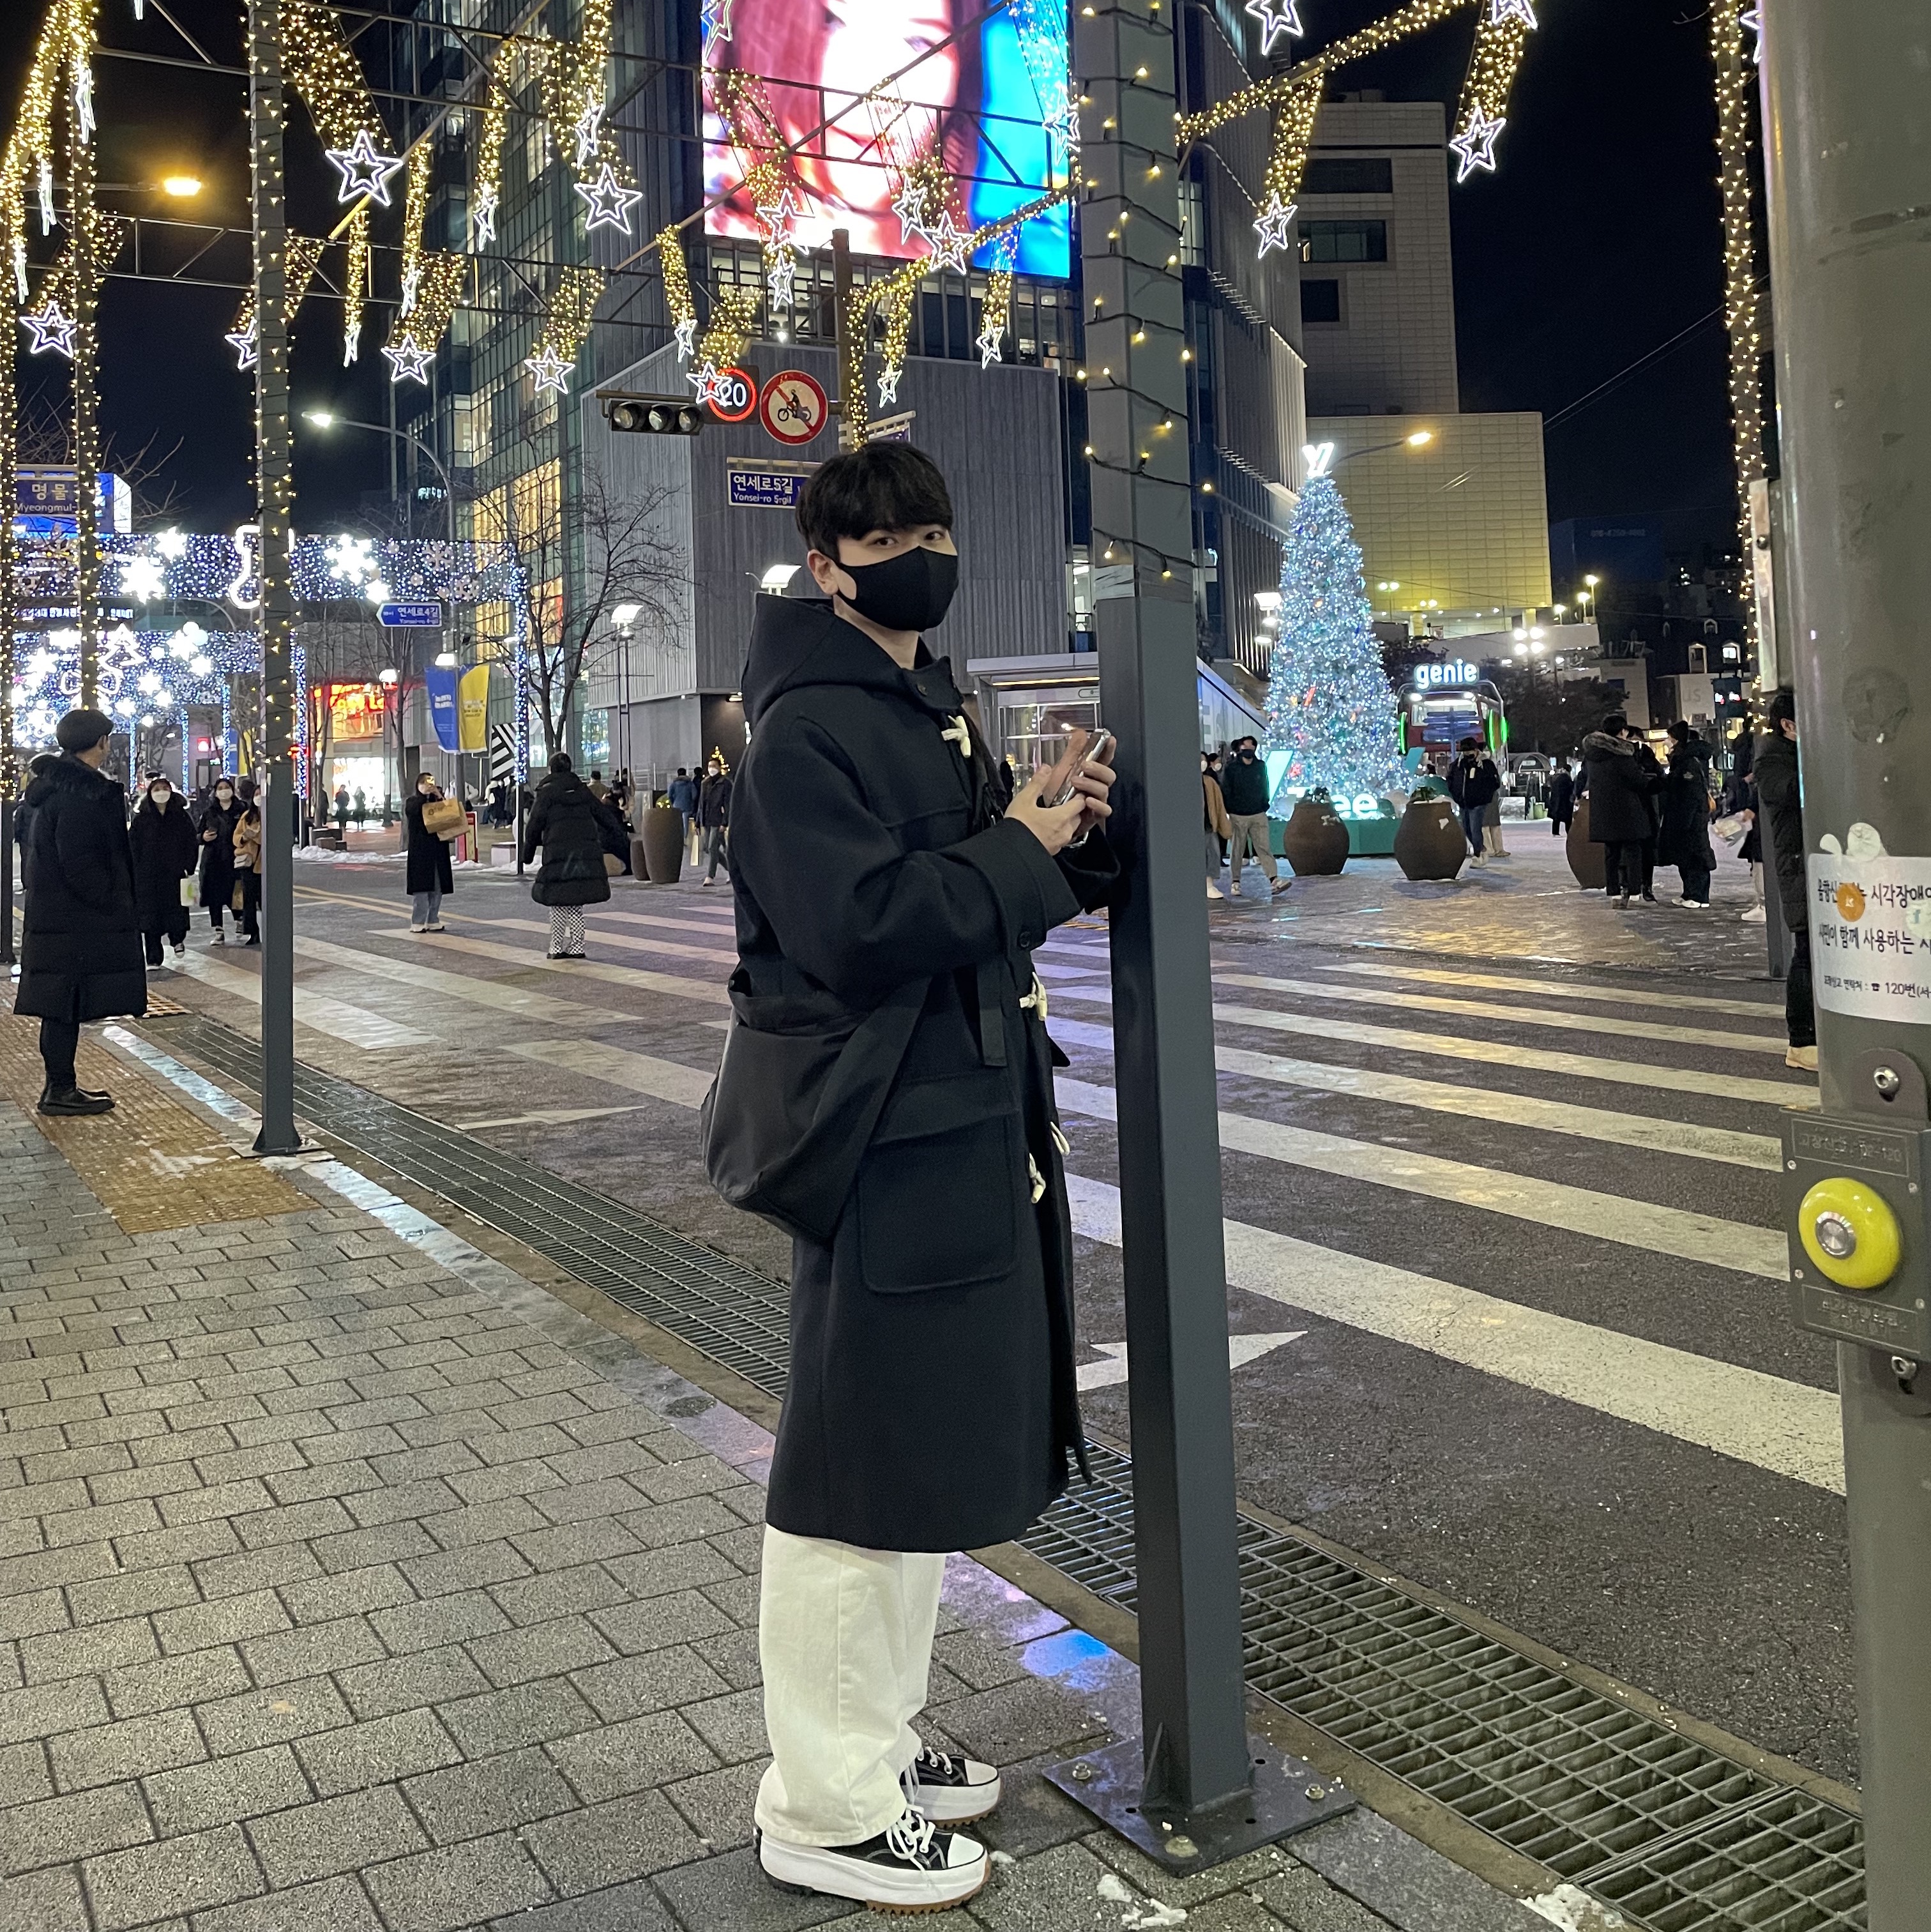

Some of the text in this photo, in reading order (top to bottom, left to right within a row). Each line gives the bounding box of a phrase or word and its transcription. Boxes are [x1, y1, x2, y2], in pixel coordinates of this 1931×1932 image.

[723, 383, 746, 407] 20
[32, 483, 79, 501] 명물
[733, 475, 793, 494] 연세로5길
[733, 492, 792, 505] Yonsei-ro 5-gil
[397, 607, 438, 618] 연세로4길
[1416, 658, 1478, 690] genie
[1840, 926, 1859, 949] 함께
[1863, 928, 1914, 954] 사용하는
[1886, 982, 1931, 999] 120번(서
